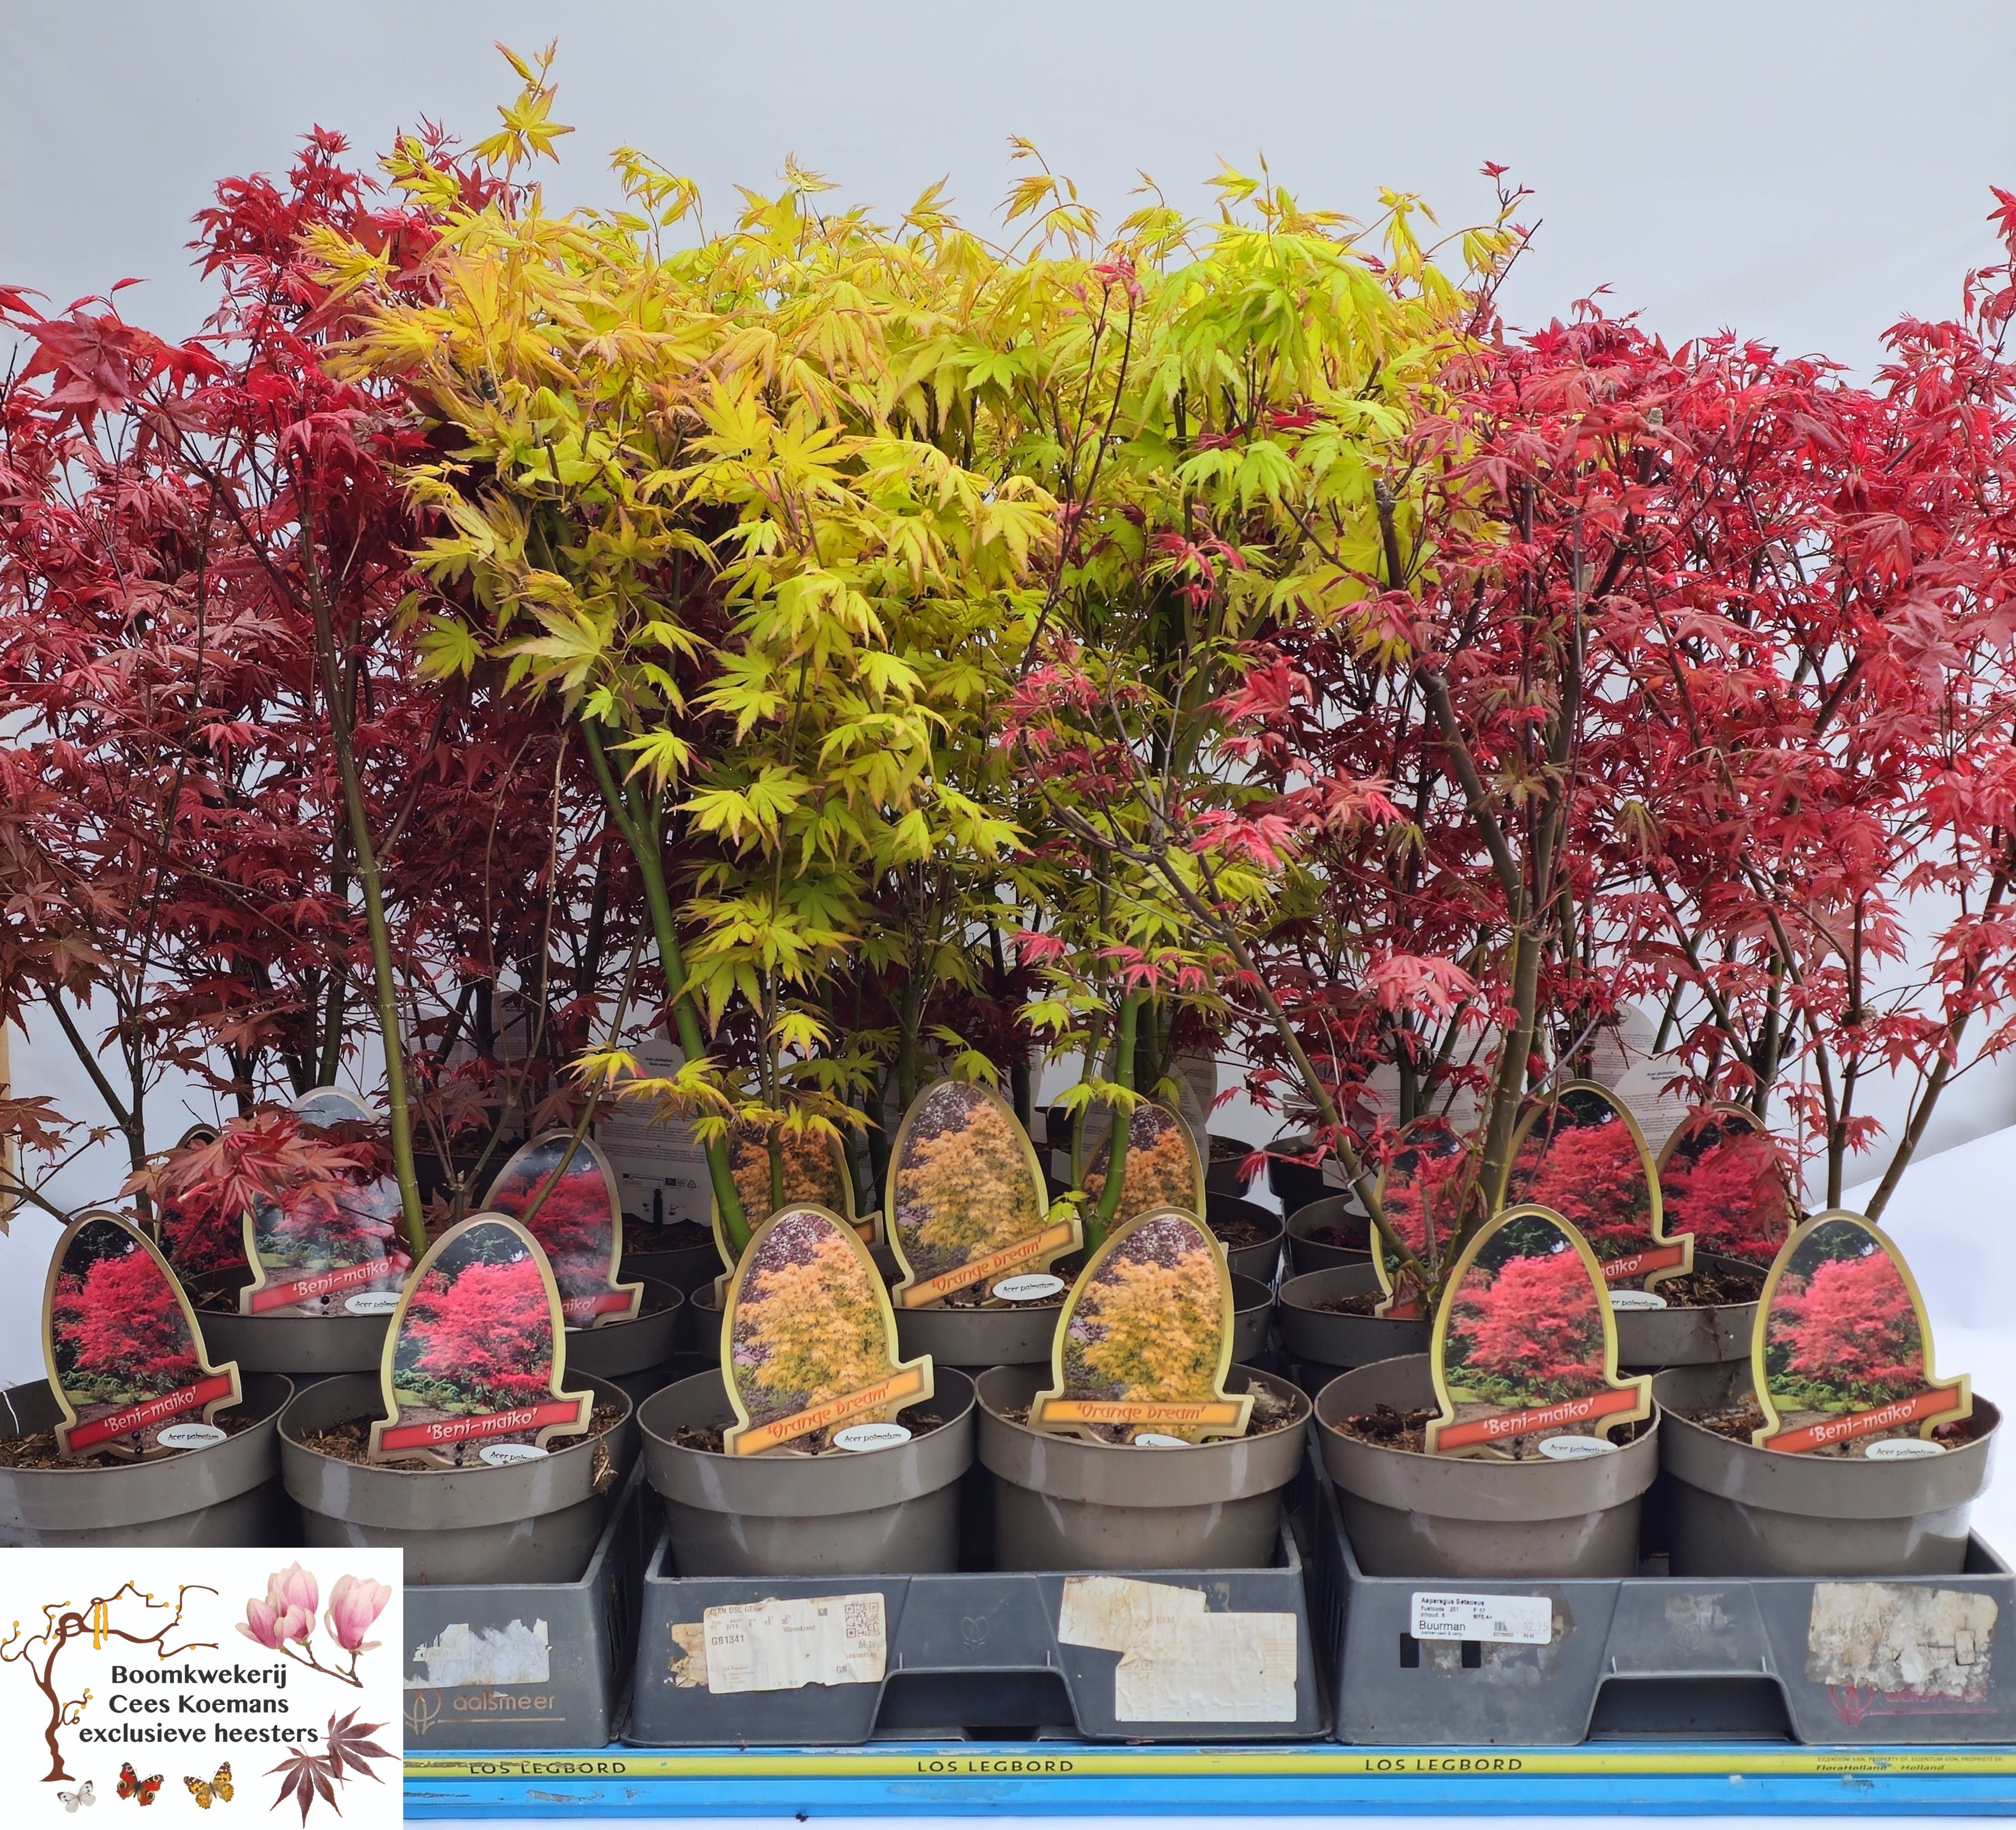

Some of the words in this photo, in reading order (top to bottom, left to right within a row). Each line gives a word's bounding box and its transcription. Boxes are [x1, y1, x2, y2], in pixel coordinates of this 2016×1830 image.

[167, 1433, 185, 1441] Acer
[844, 1434, 862, 1442] Acer
[1550, 1444, 1568, 1452] Acer
[489, 1450, 509, 1460] Acer
[1419, 1620, 1466, 1631] Buurman
[712, 1634, 745, 1646] GB1341
[454, 1690, 555, 1711] aalsmeer
[470, 1761, 510, 1775] LOS
[522, 1761, 626, 1775] LEGBORD
[918, 1761, 958, 1772] LOS
[969, 1760, 1074, 1772] LEGBORD
[1365, 1759, 1405, 1771] LOS
[1417, 1758, 1522, 1771] LEGBORD
